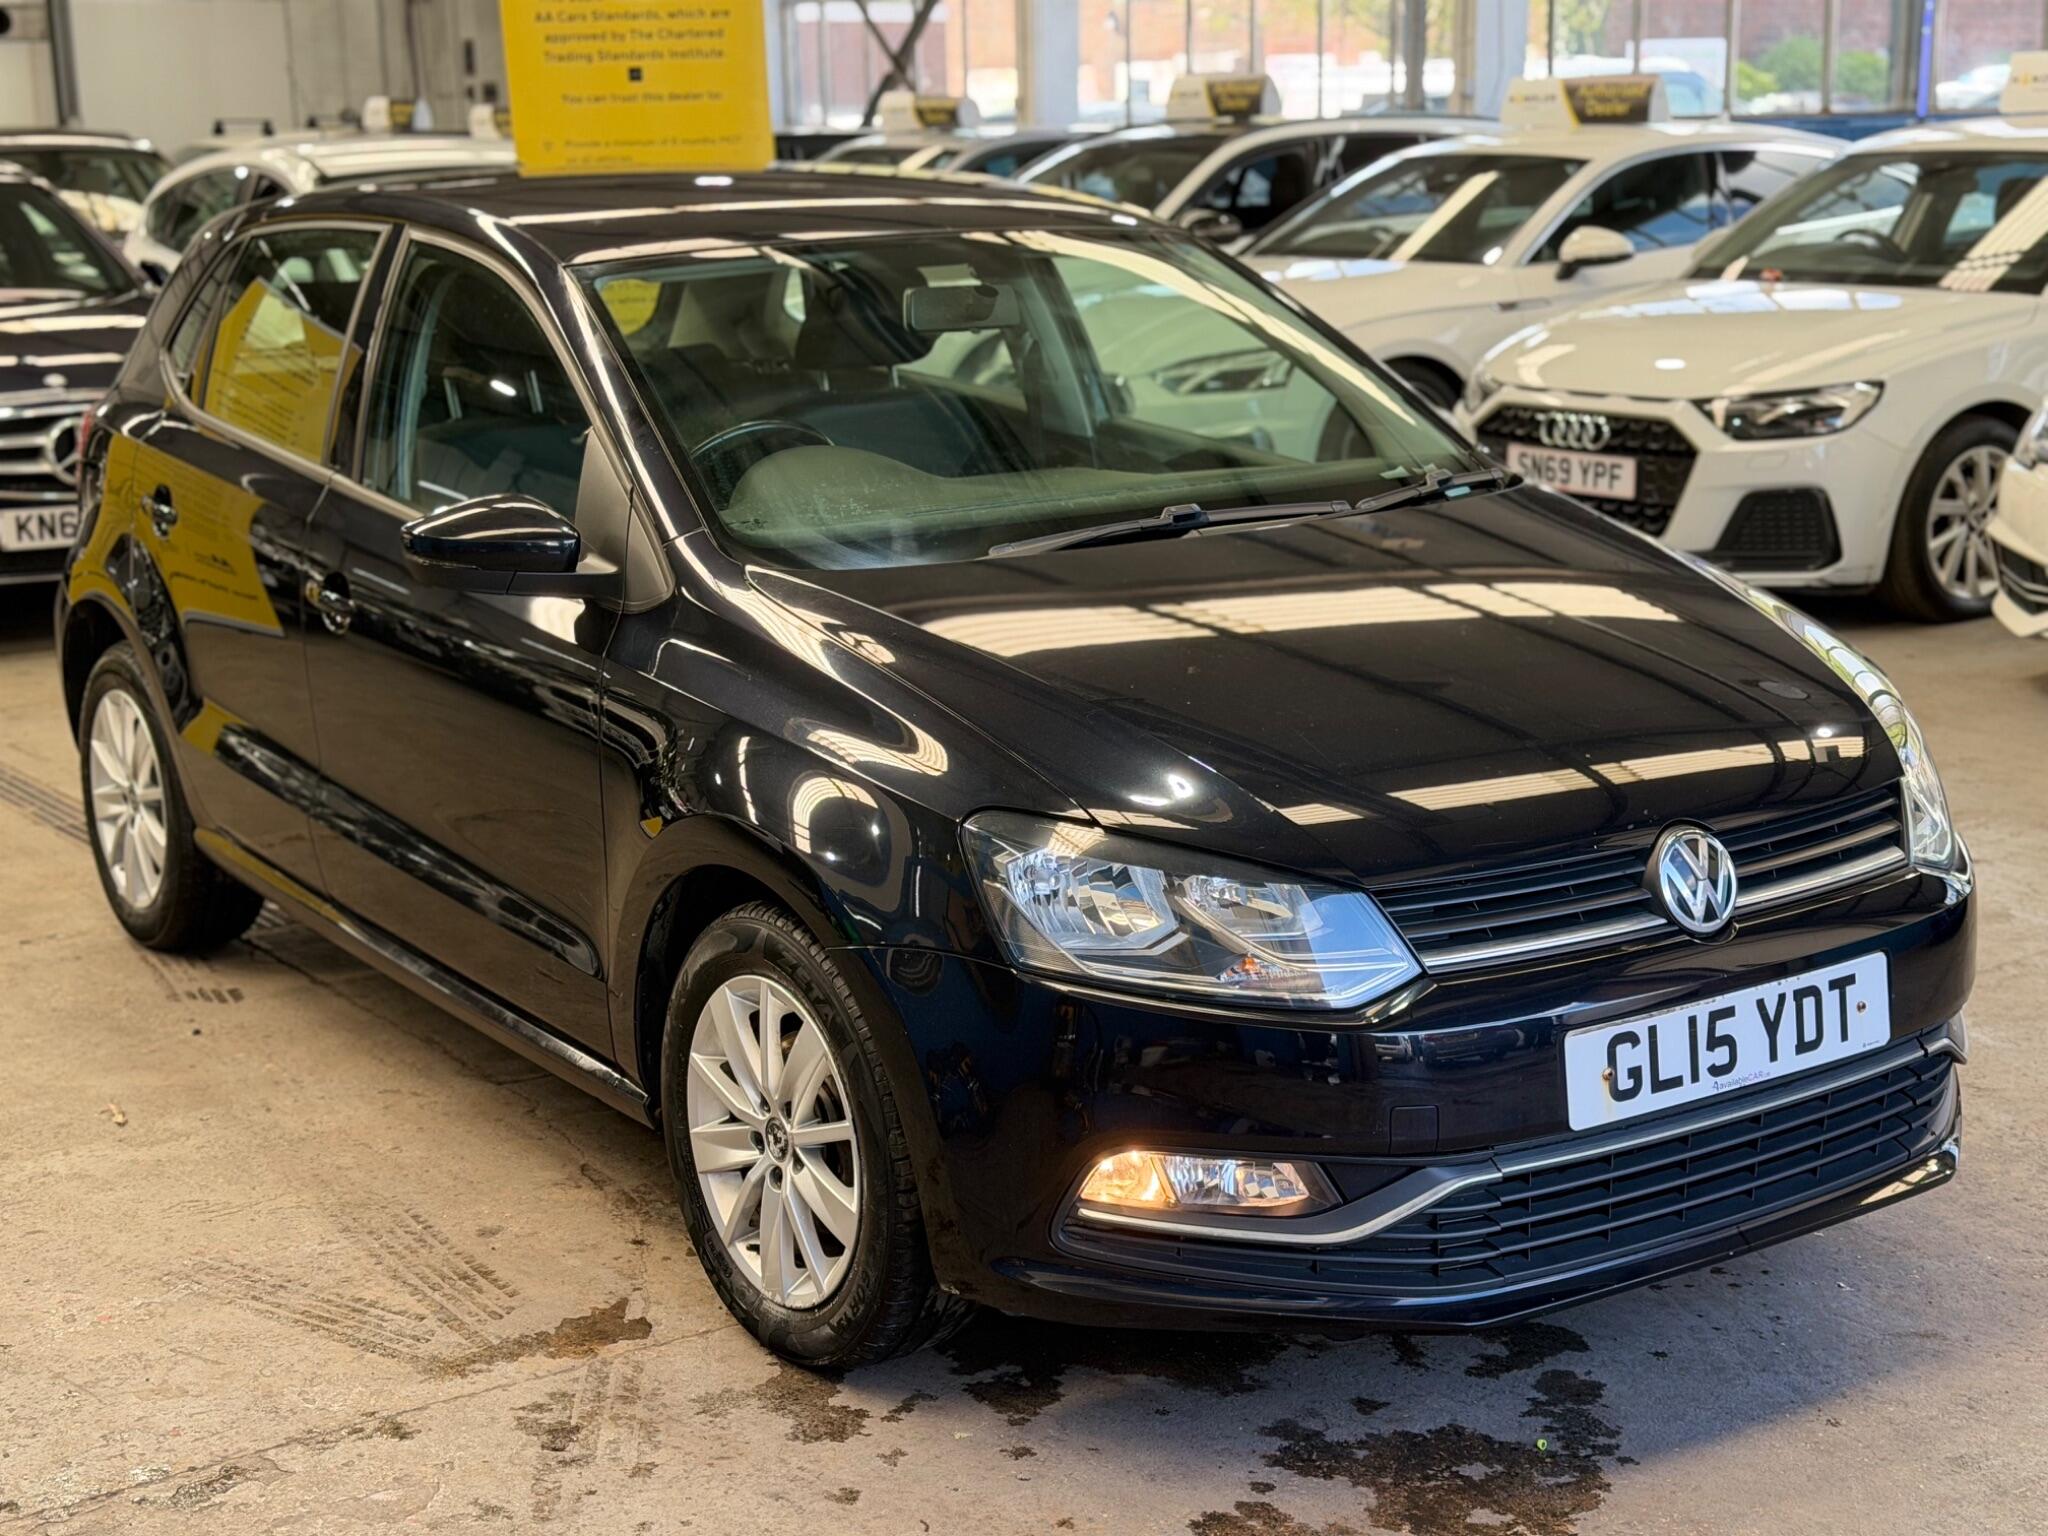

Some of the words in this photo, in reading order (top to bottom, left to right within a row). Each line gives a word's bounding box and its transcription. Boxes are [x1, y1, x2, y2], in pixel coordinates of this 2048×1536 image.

[1517, 451, 1572, 485] SN69
[1578, 458, 1623, 491] YPF
[1606, 1005, 1738, 1103] GL15
[1756, 972, 1857, 1064] YDT
